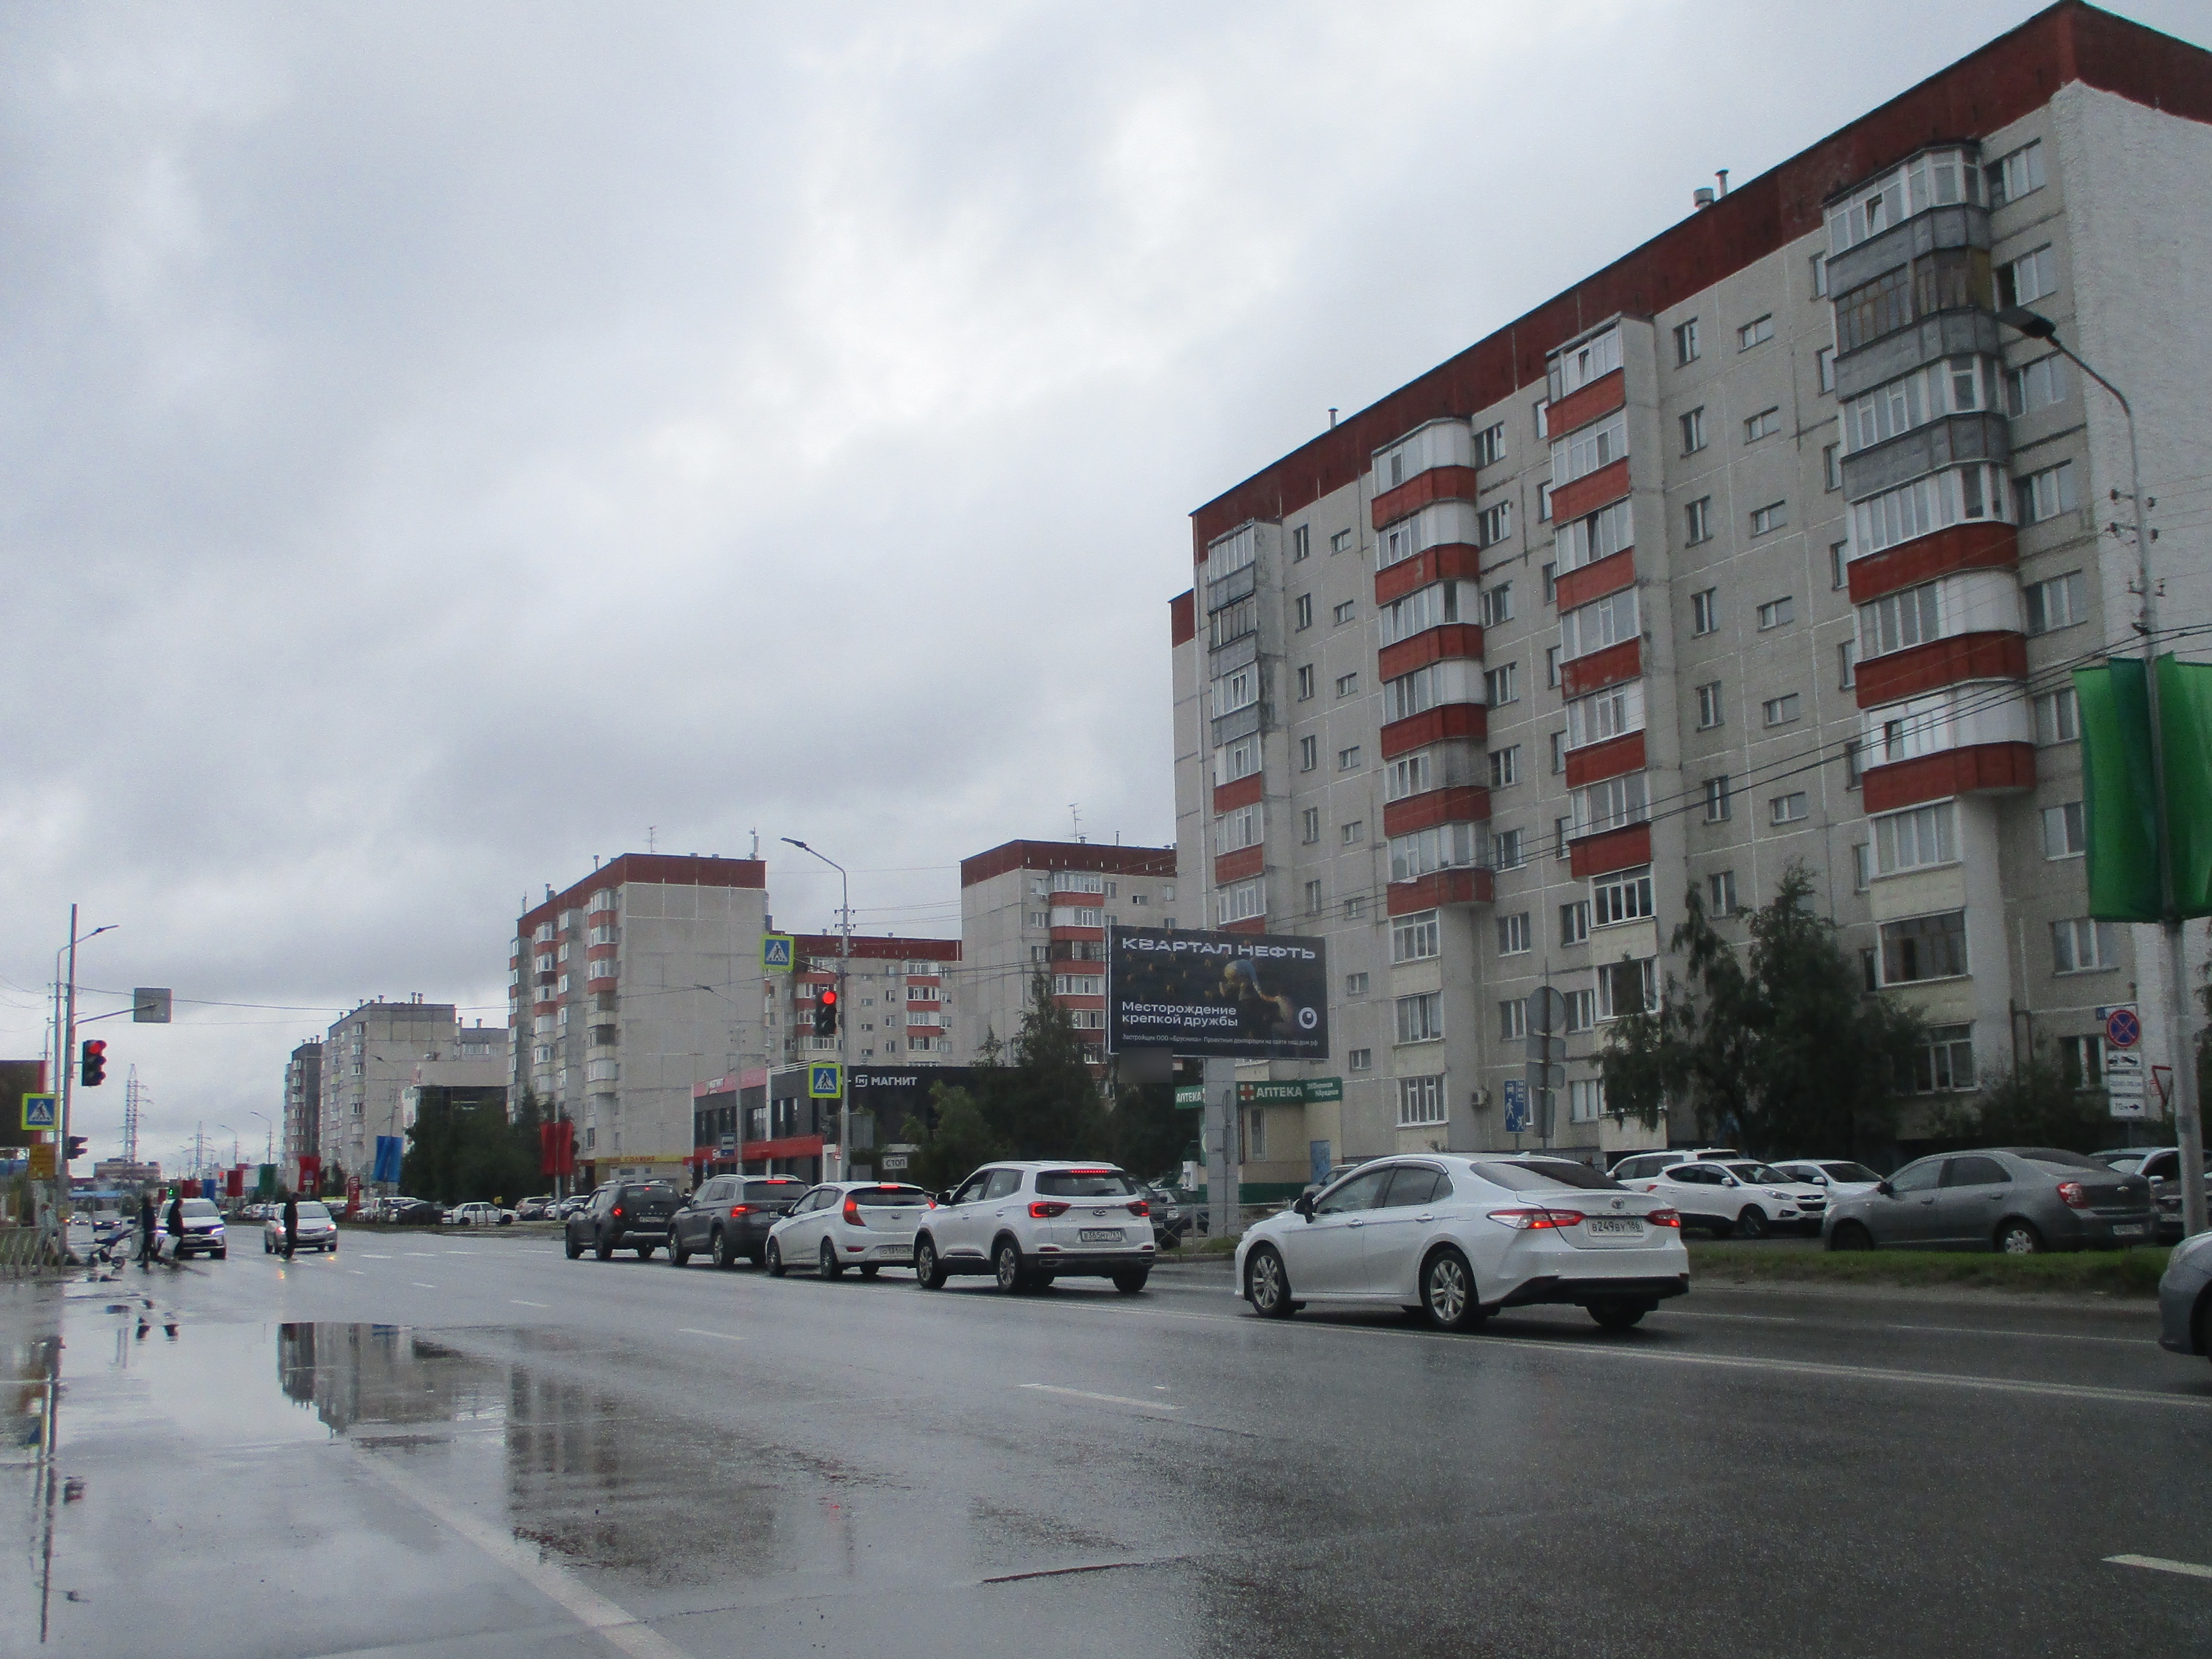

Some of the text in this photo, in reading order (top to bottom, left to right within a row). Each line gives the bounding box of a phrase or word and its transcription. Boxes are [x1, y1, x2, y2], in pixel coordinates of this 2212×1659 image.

[1122, 937, 1315, 959] КВАРТАЛ НЕФТЬ
[1122, 1001, 1236, 1015] Месторождение
[1122, 1014, 1238, 1027] крепкой дружбы
[1123, 1033, 1156, 1041] Застройщик
[871, 1076, 918, 1086] МАГНИТ
[1177, 1091, 1202, 1103] АПТЕКА
[1256, 1086, 1302, 1098] АПТЕКА
[886, 1159, 905, 1167] СТОП
